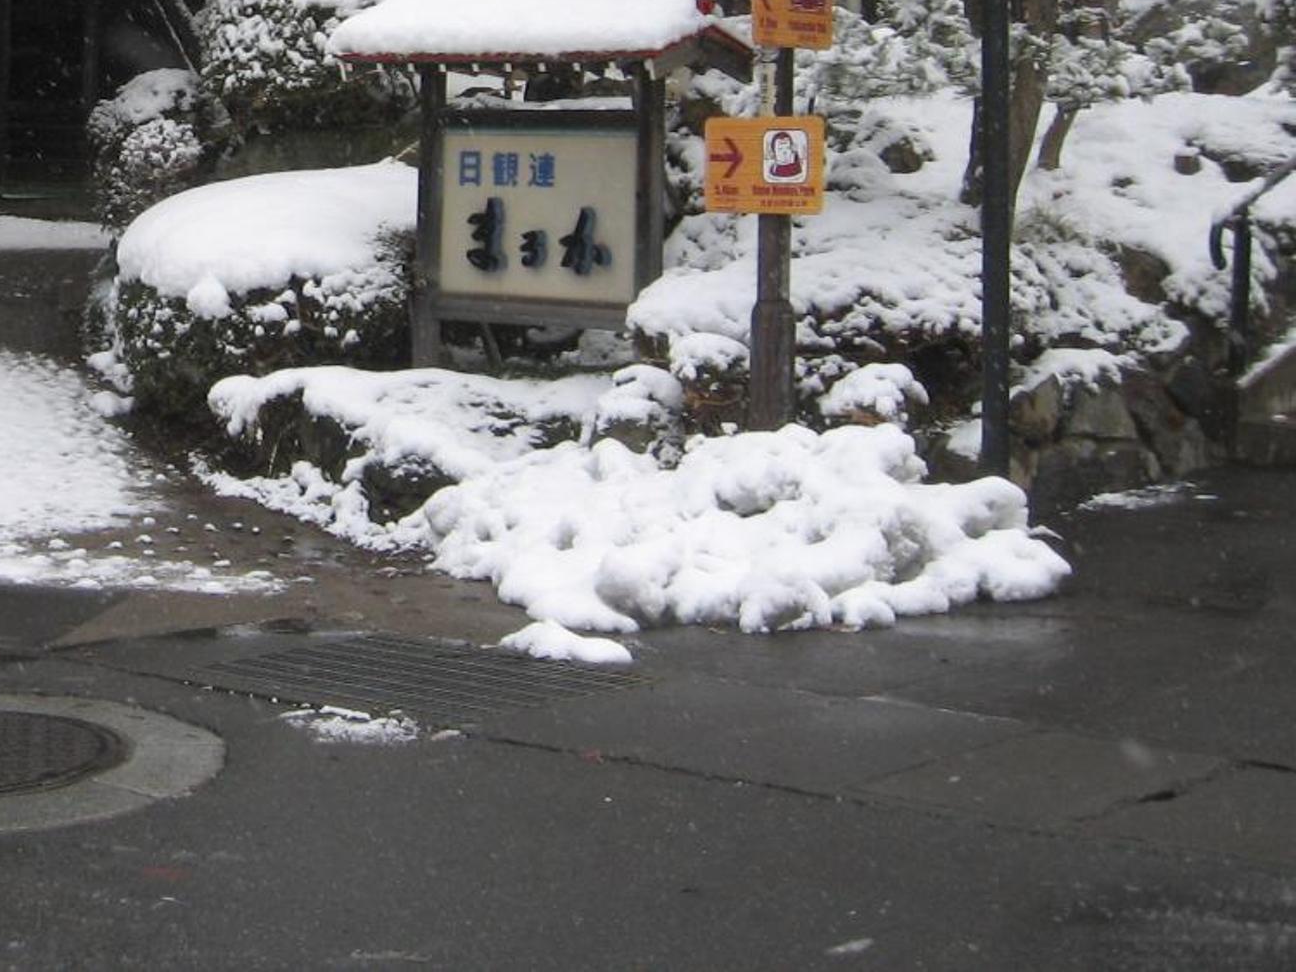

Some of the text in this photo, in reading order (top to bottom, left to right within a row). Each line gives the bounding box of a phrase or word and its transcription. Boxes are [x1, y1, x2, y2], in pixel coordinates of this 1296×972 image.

[460, 151, 555, 187] 日観連
[466, 197, 613, 276] まるか
